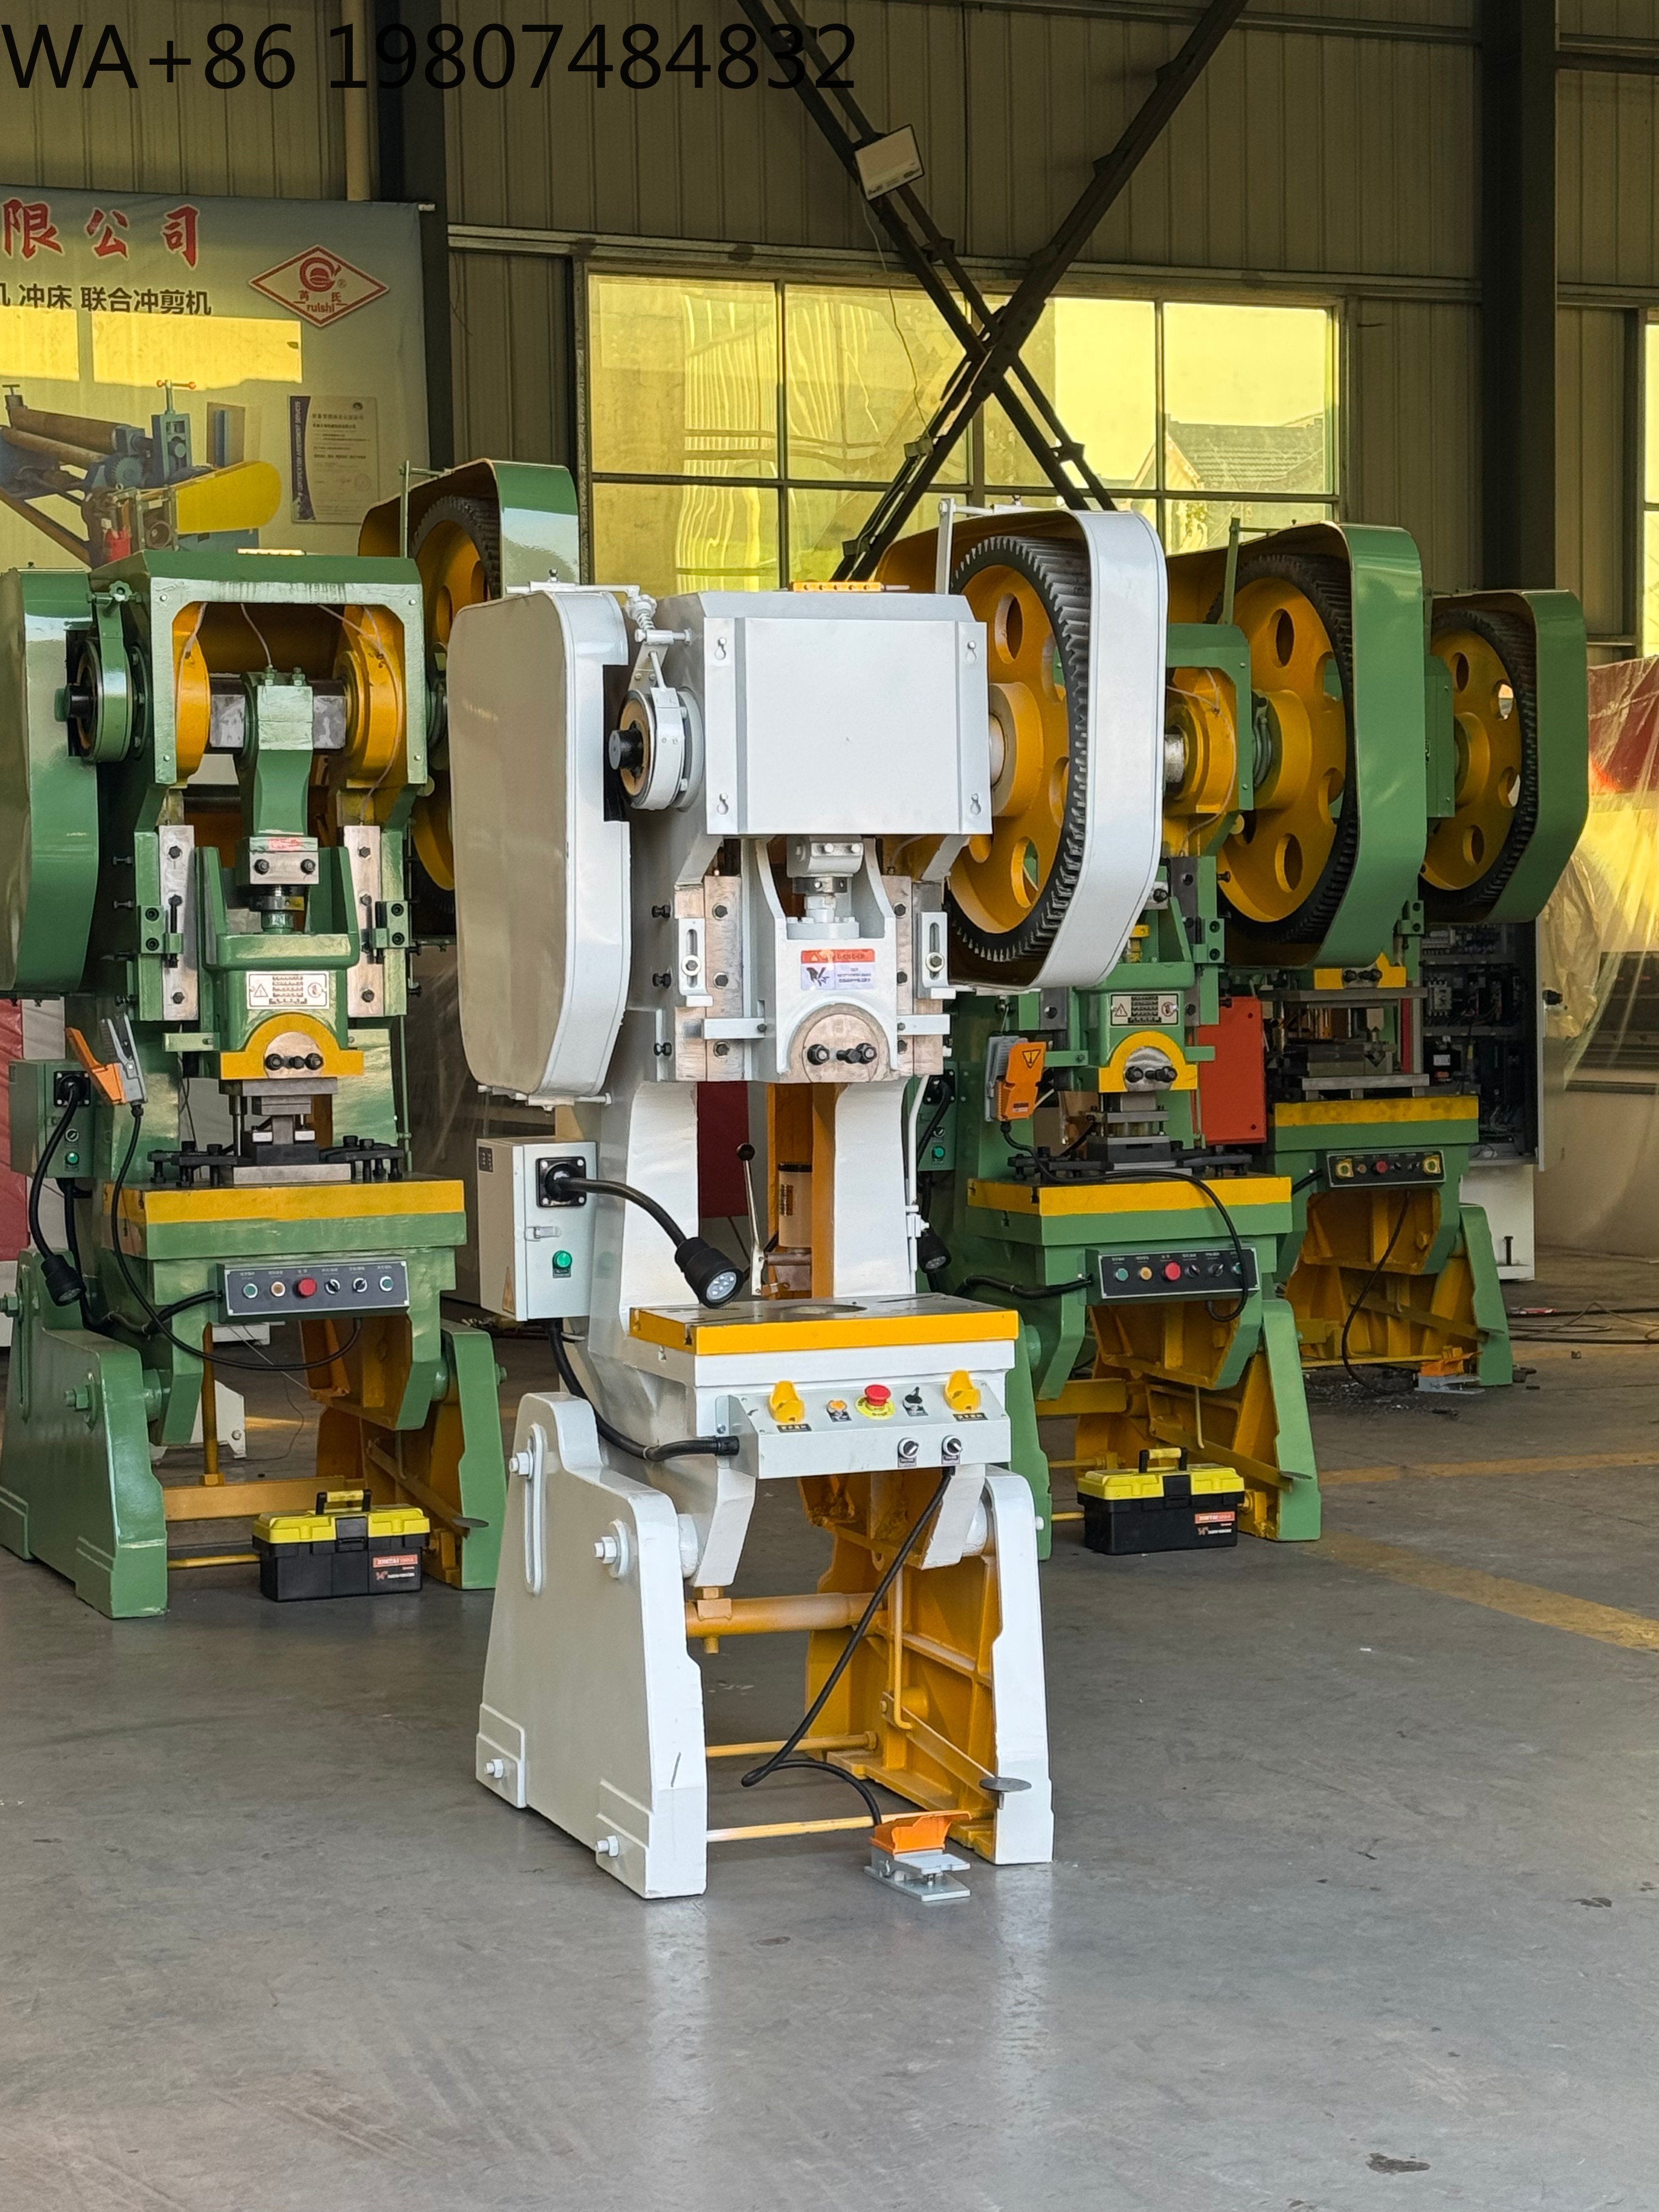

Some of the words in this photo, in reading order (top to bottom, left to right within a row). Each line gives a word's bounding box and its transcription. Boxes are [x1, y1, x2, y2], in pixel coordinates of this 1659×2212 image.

[3, 198, 199, 269] 限公司
[18, 283, 72, 310] 冲床
[80, 285, 212, 317] 联合冲剪机
[307, 302, 335, 313] ruishi
